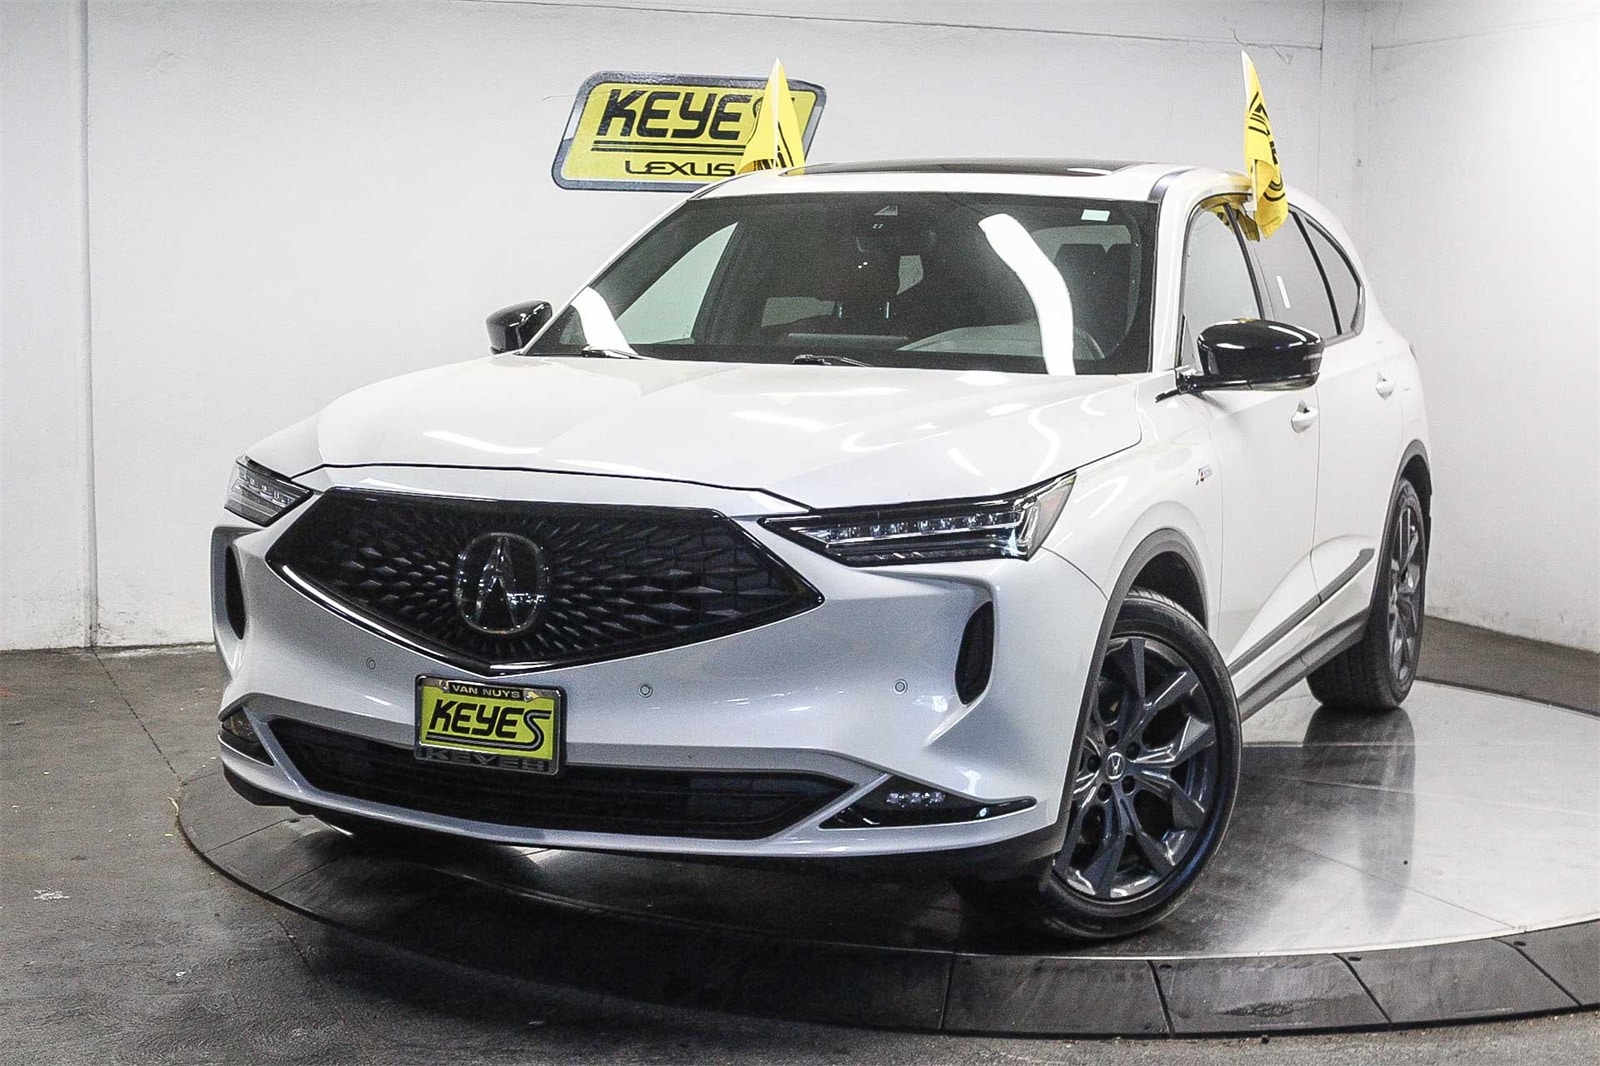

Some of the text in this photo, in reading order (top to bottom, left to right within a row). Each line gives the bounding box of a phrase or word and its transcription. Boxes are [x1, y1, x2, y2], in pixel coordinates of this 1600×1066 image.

[624, 160, 736, 177] LEXUS
[451, 684, 520, 699] VAN NUYS
[428, 699, 552, 750] KEYES
